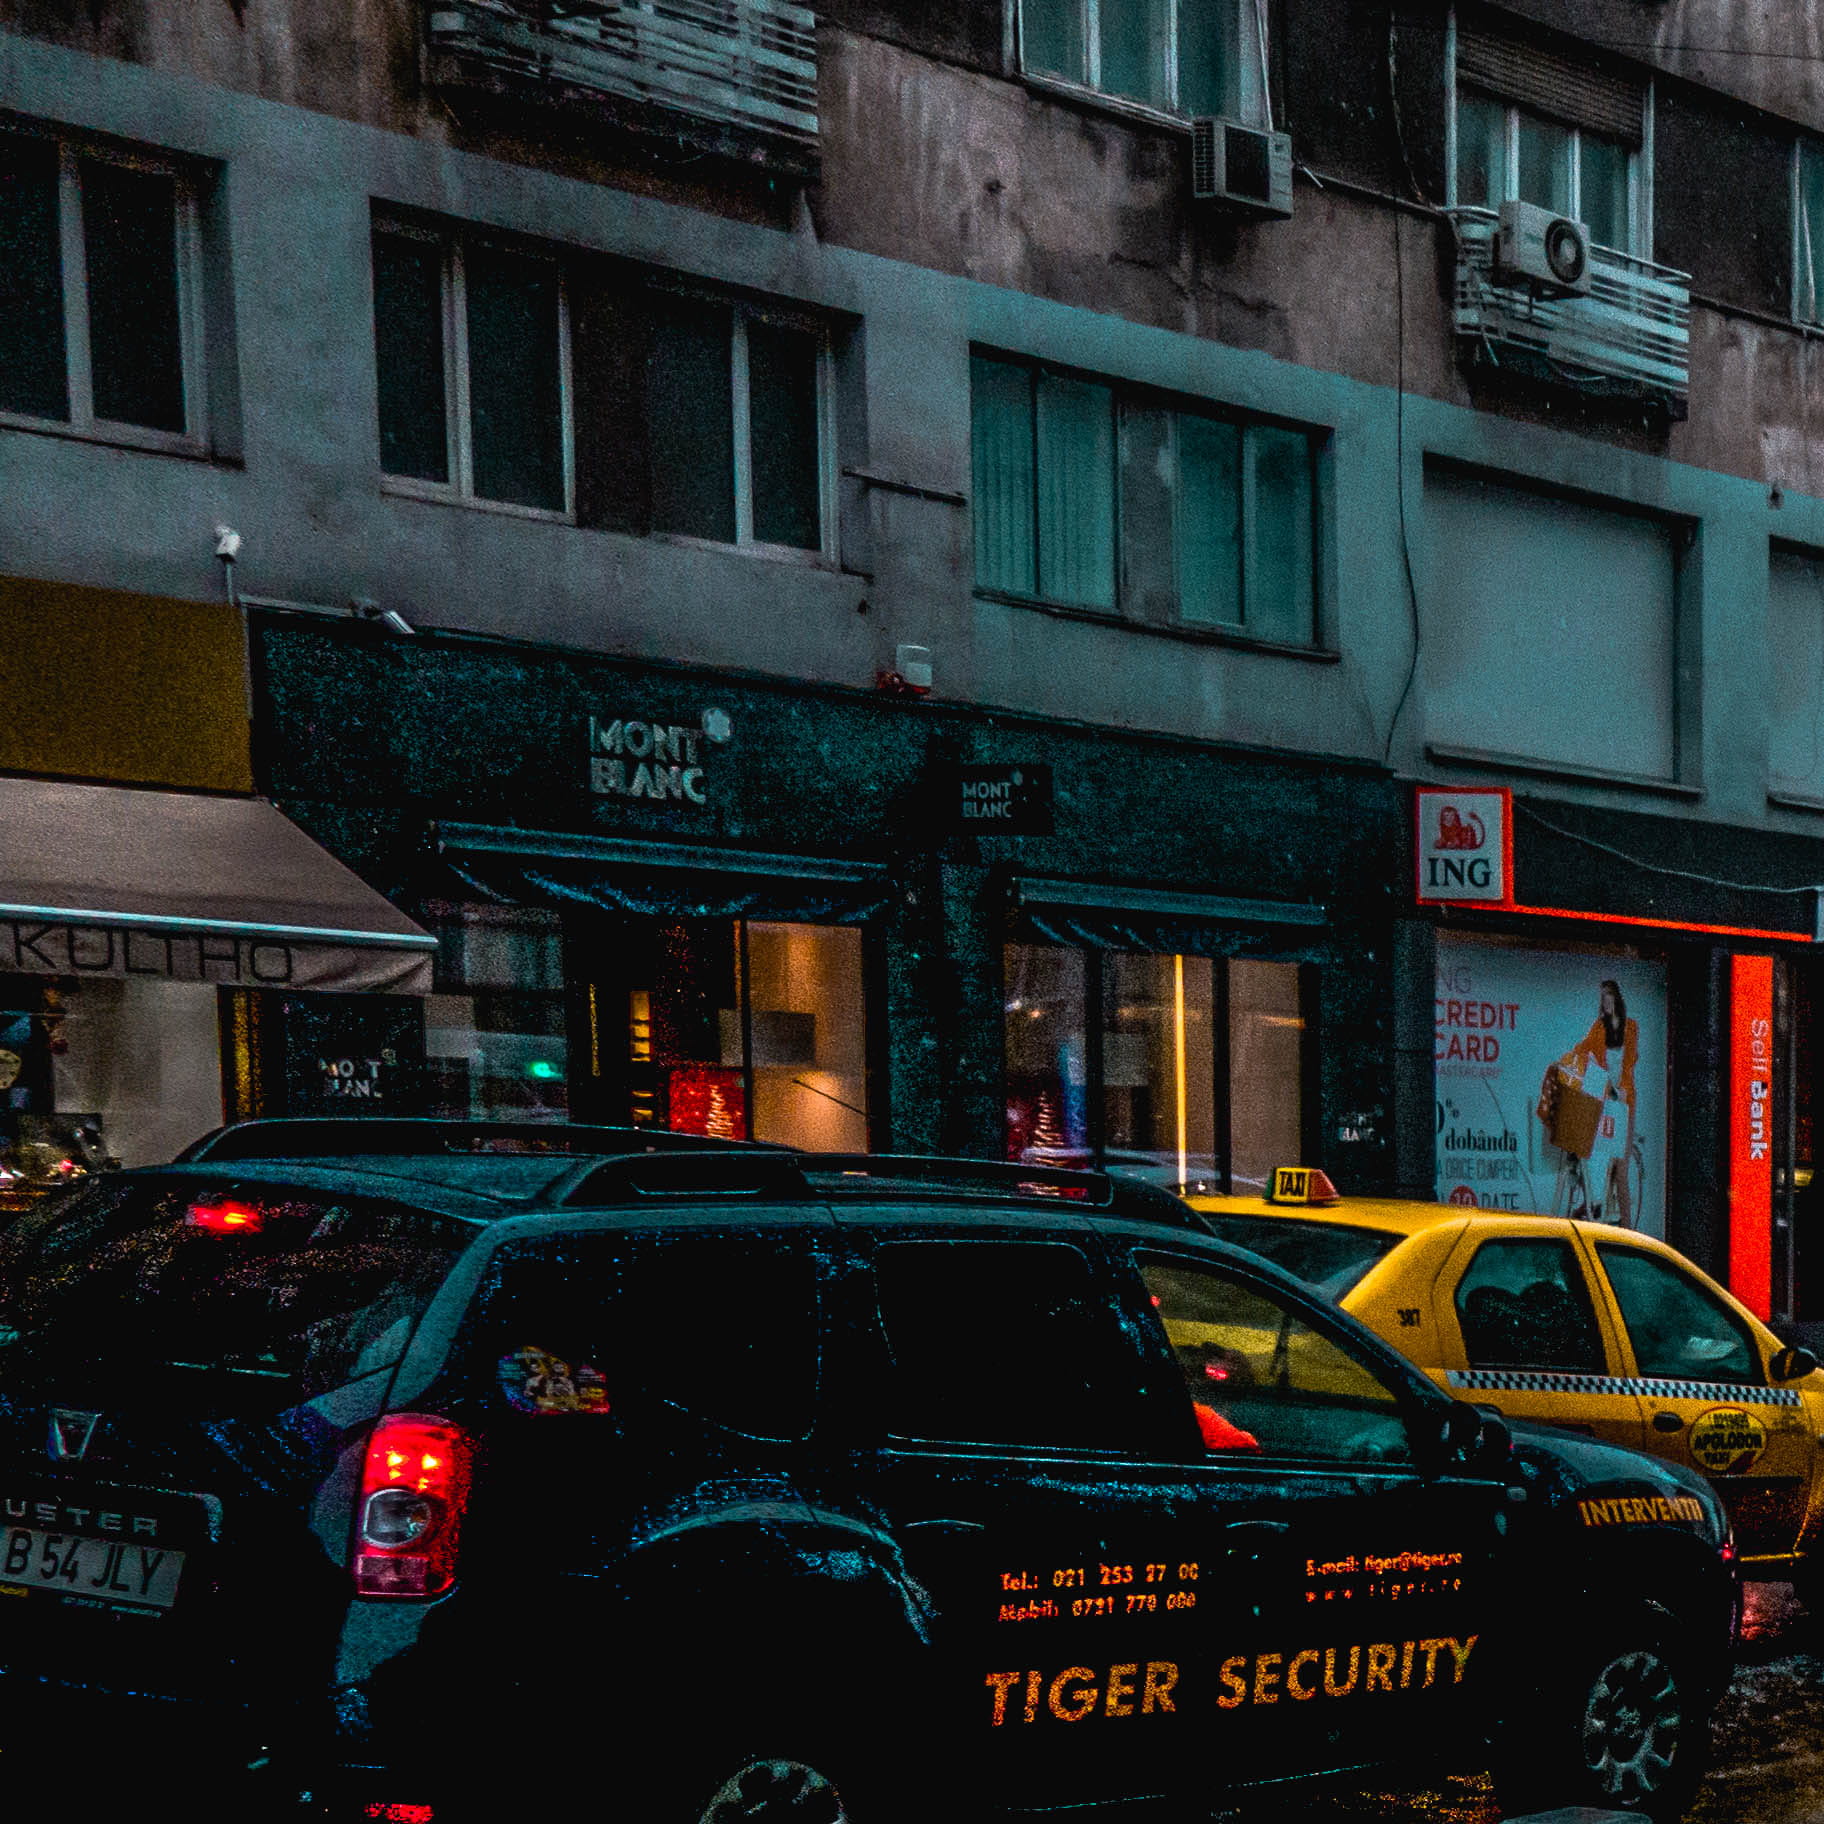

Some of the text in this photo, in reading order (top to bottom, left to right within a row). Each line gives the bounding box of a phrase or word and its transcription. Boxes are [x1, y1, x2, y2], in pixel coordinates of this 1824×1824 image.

[590, 716, 700, 765] MONT
[590, 757, 706, 803] BLANC
[961, 780, 1011, 800] MONT
[962, 799, 1013, 819] BLANC
[1427, 857, 1492, 888] ING
[14, 921, 292, 983] KULTHO
[1750, 1080, 1769, 1161] Bank
[1279, 1170, 1306, 1197] TAXI
[4, 1529, 166, 1596] B 54 JLY
[985, 1634, 1480, 1728] TIGER SECURITY
